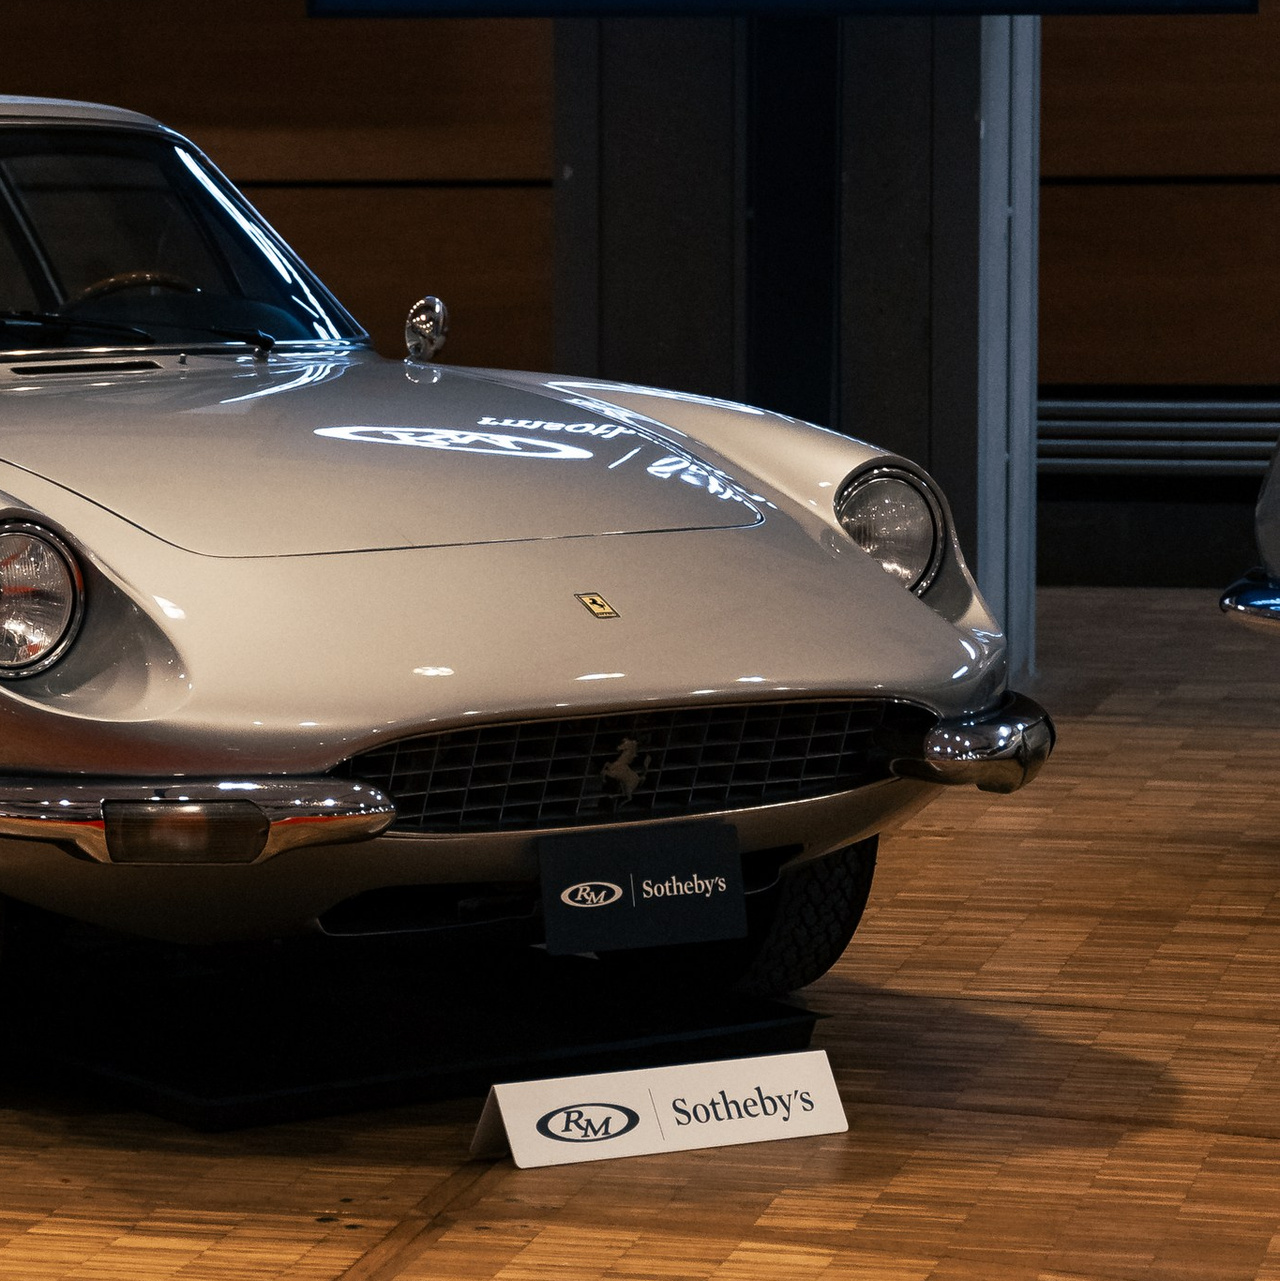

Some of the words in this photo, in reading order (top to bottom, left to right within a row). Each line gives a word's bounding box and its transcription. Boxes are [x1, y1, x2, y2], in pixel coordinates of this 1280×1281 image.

[573, 884, 608, 905] RM
[642, 873, 727, 899] Sotheby's
[560, 1108, 613, 1139] RM
[671, 1085, 815, 1126] Sotheby's
